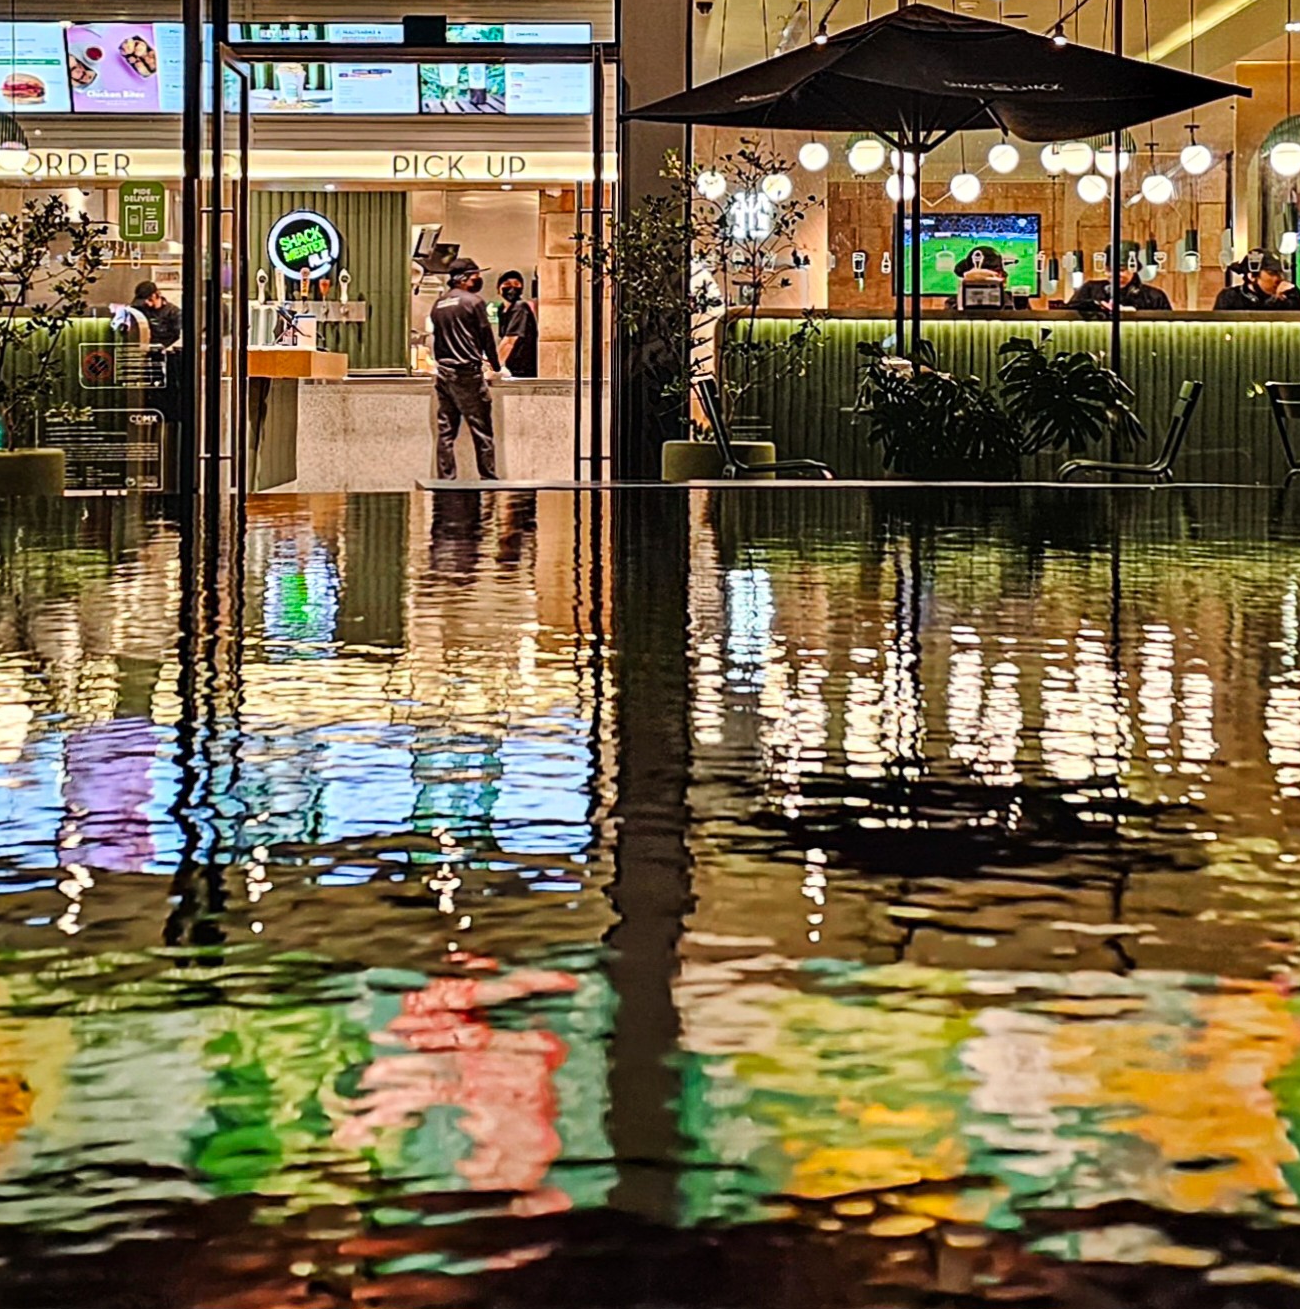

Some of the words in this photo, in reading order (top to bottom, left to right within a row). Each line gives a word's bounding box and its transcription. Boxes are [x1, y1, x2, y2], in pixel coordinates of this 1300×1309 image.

[393, 154, 465, 179] PICK
[487, 155, 526, 178] UP
[123, 194, 161, 202] DELIVERY
[279, 225, 323, 251] SHACK
[283, 238, 327, 262] MEISTER
[129, 414, 158, 423] CDMX
